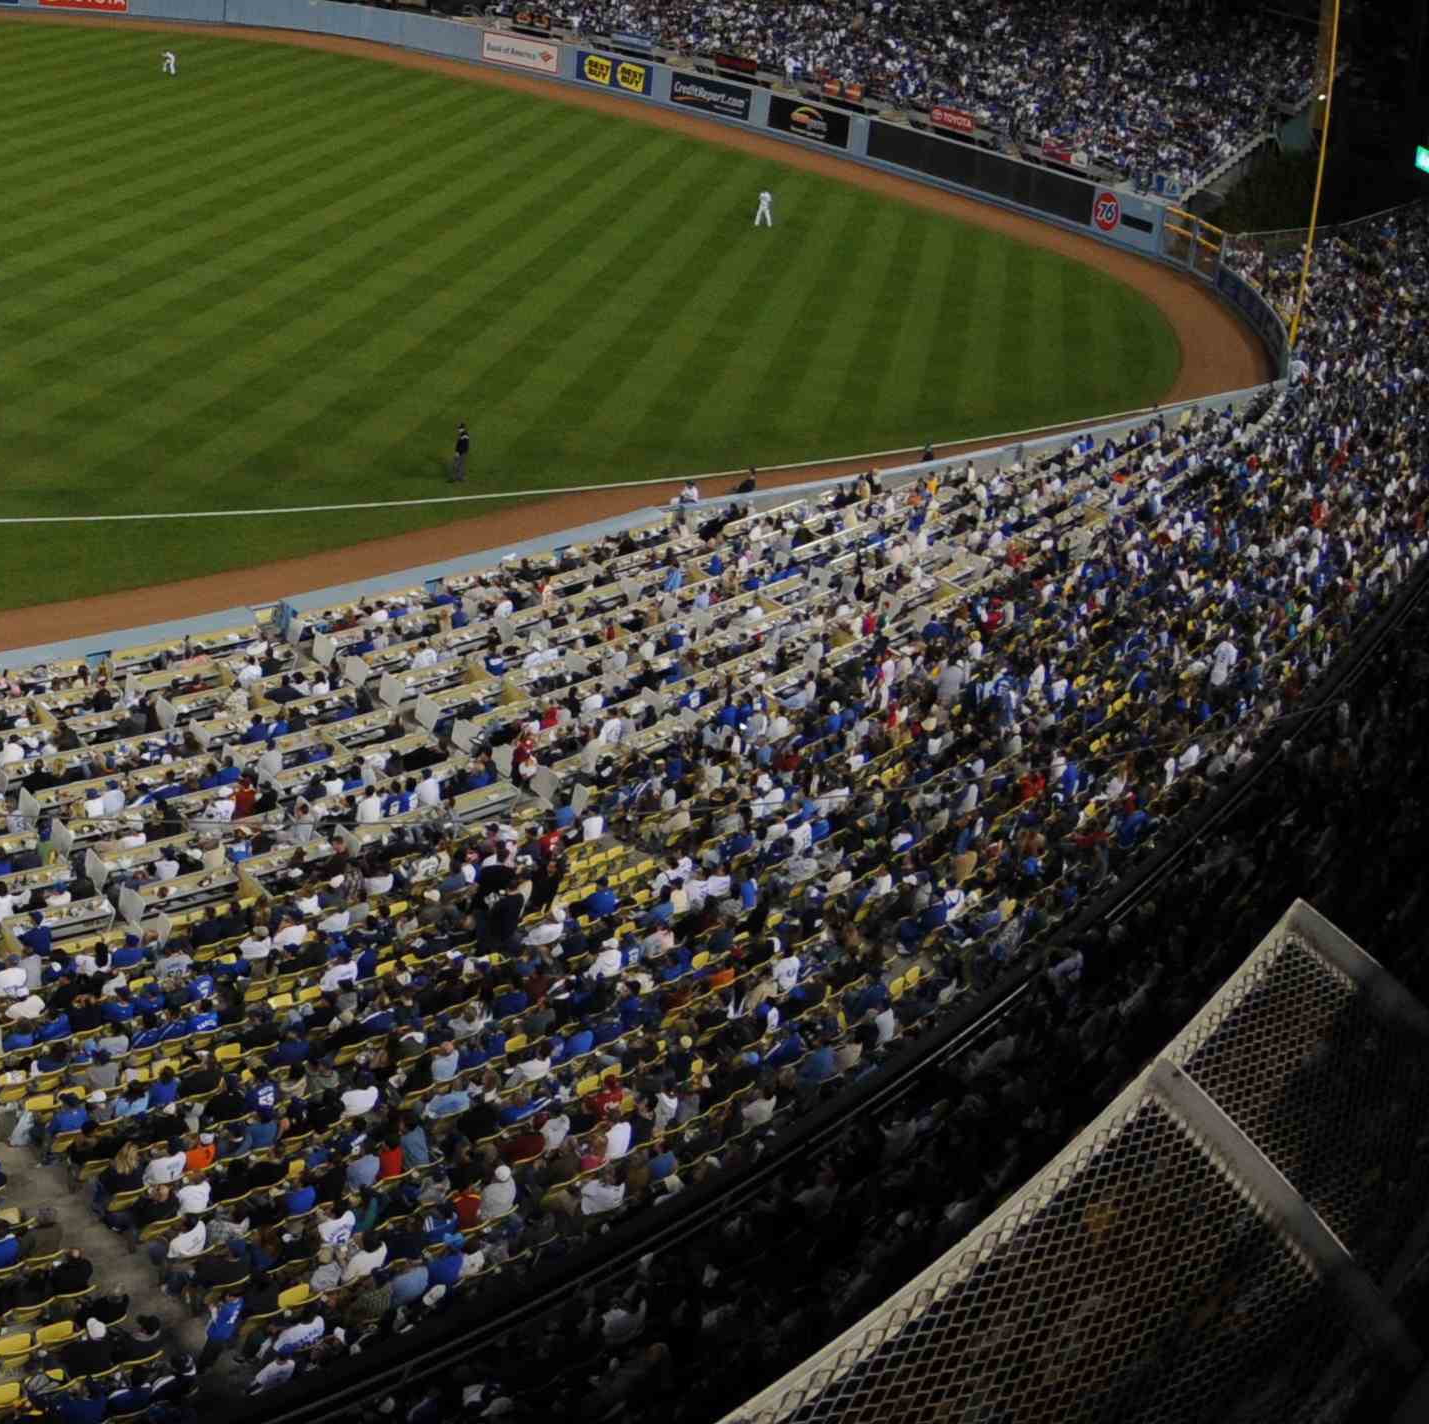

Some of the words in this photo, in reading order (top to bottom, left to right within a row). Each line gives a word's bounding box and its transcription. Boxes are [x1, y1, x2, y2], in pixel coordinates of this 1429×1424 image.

[588, 60, 610, 72] BEST
[620, 67, 643, 78] BEST
[588, 68, 608, 81] BUY
[620, 76, 640, 88] BUY
[674, 80, 745, 109] CreditReport.com
[942, 111, 972, 127] TOYOTA
[1096, 202, 1115, 223] 76
